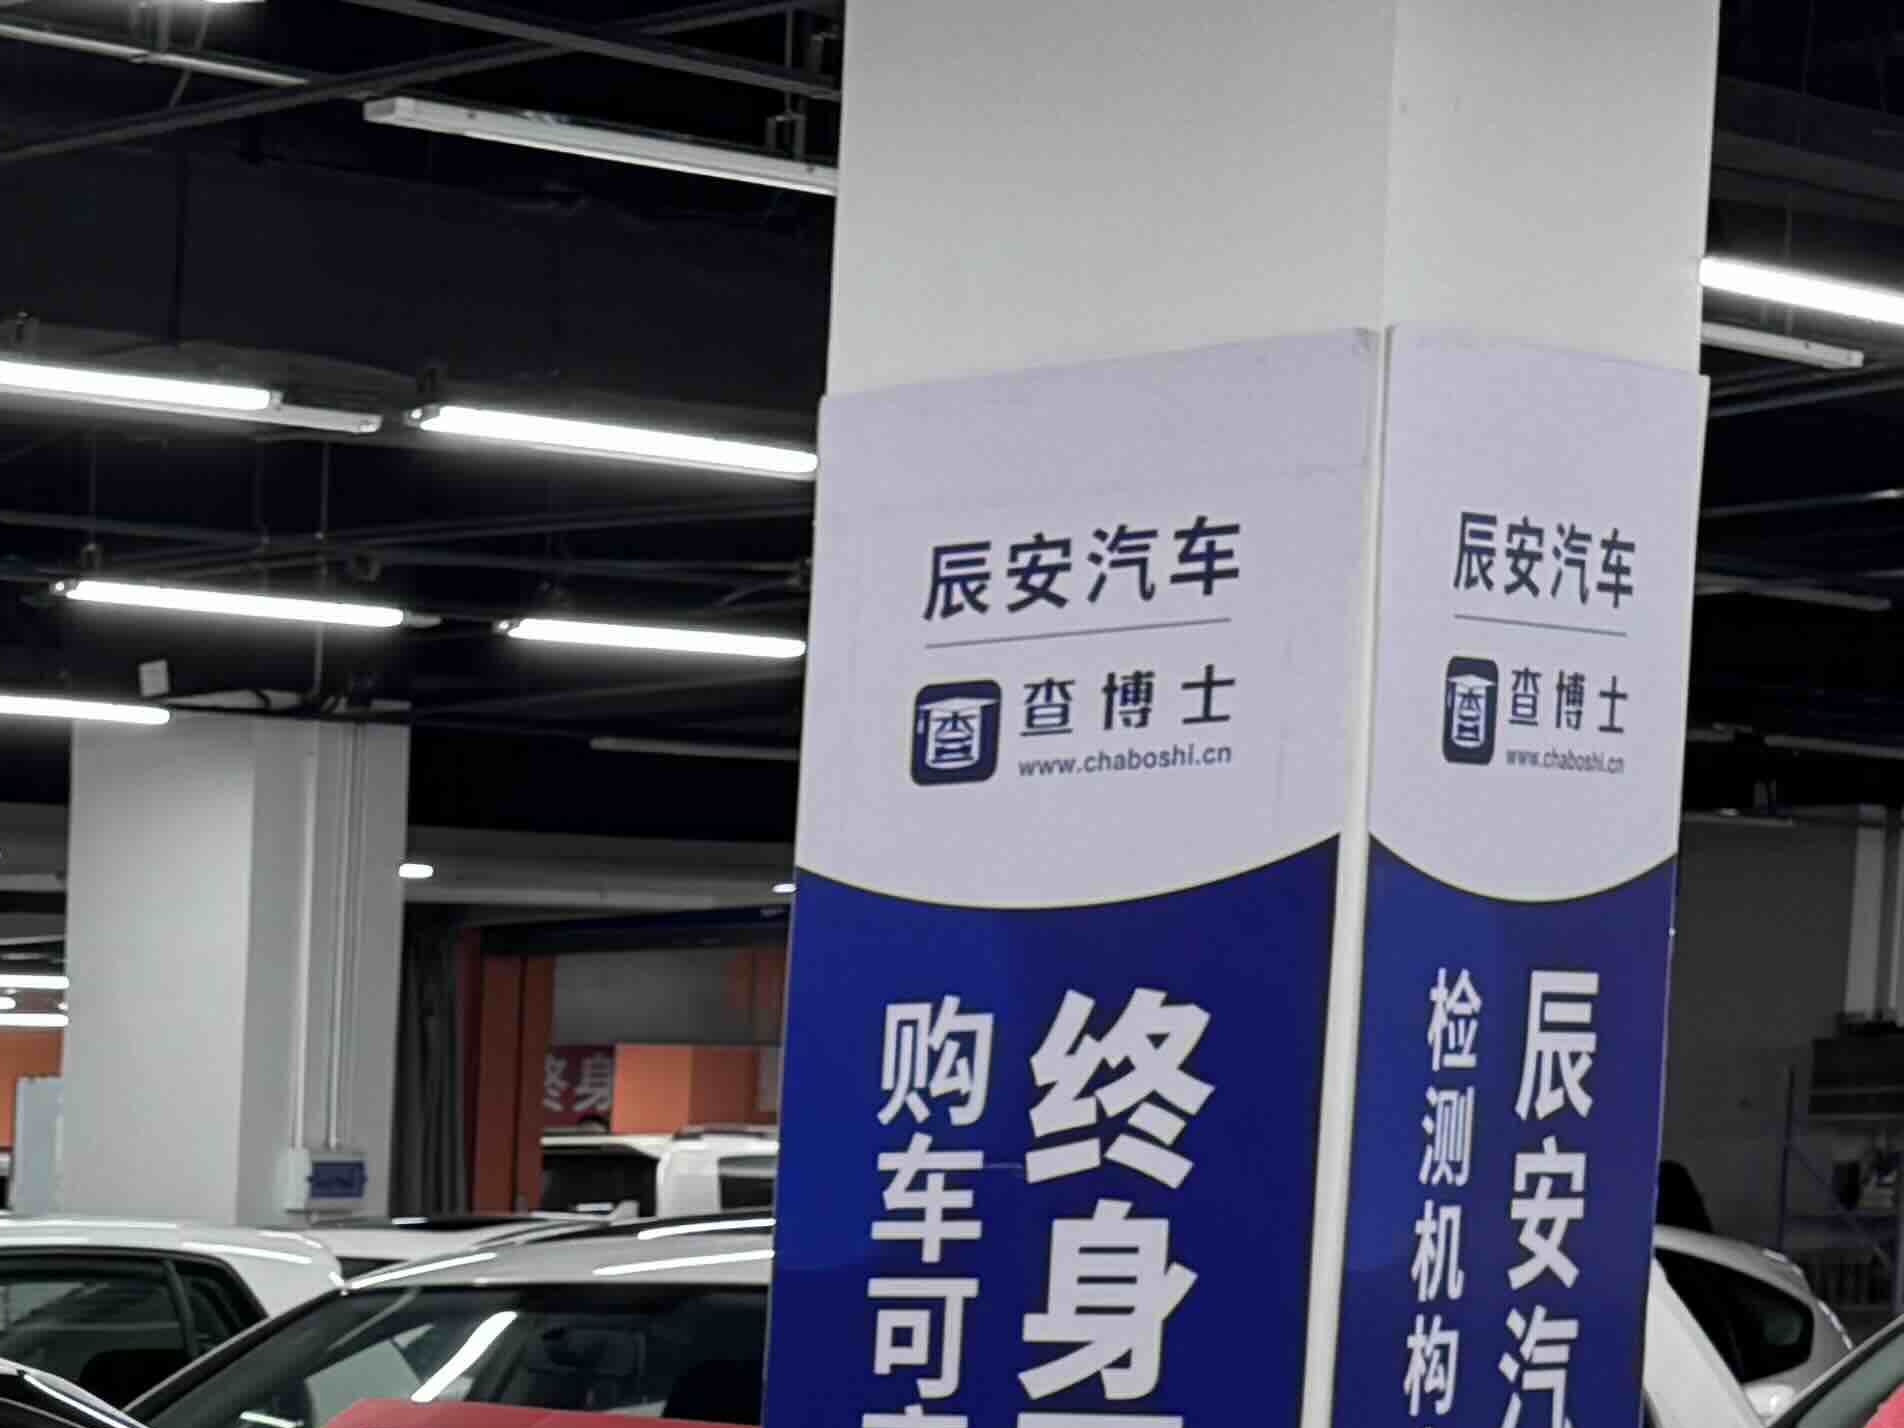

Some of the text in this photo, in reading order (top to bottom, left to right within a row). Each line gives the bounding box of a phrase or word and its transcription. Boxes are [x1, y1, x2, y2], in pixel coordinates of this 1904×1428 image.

[923, 515, 1240, 621] 辰安汽车
[1453, 511, 1635, 608] 辰安汽车
[1020, 664, 1236, 736] 查博士
[1508, 667, 1629, 734] 查博士
[1018, 742, 1233, 777] www.chaboshi.cn
[1505, 748, 1625, 774] www.chaboshi.cn
